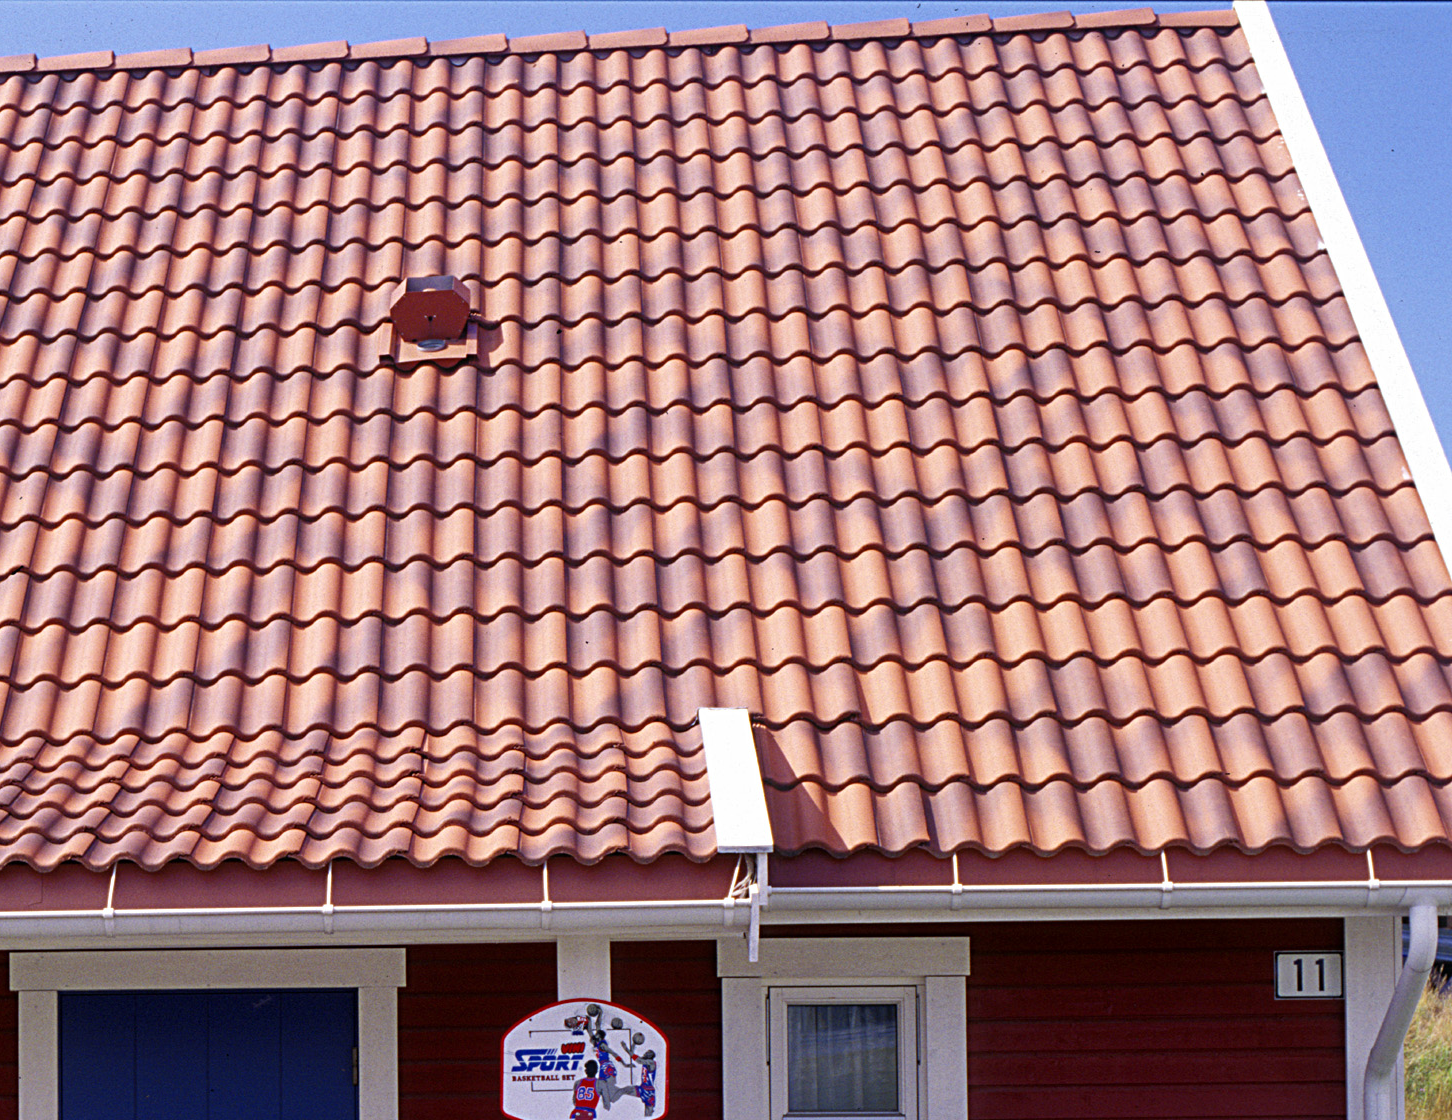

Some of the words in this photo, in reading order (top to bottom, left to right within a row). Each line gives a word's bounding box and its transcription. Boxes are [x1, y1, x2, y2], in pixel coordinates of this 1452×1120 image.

[1293, 958, 1325, 992] 11
[511, 1048, 584, 1072] SPORT
[512, 1074, 560, 1082] BASKETBALL
[576, 1086, 594, 1101] 85
